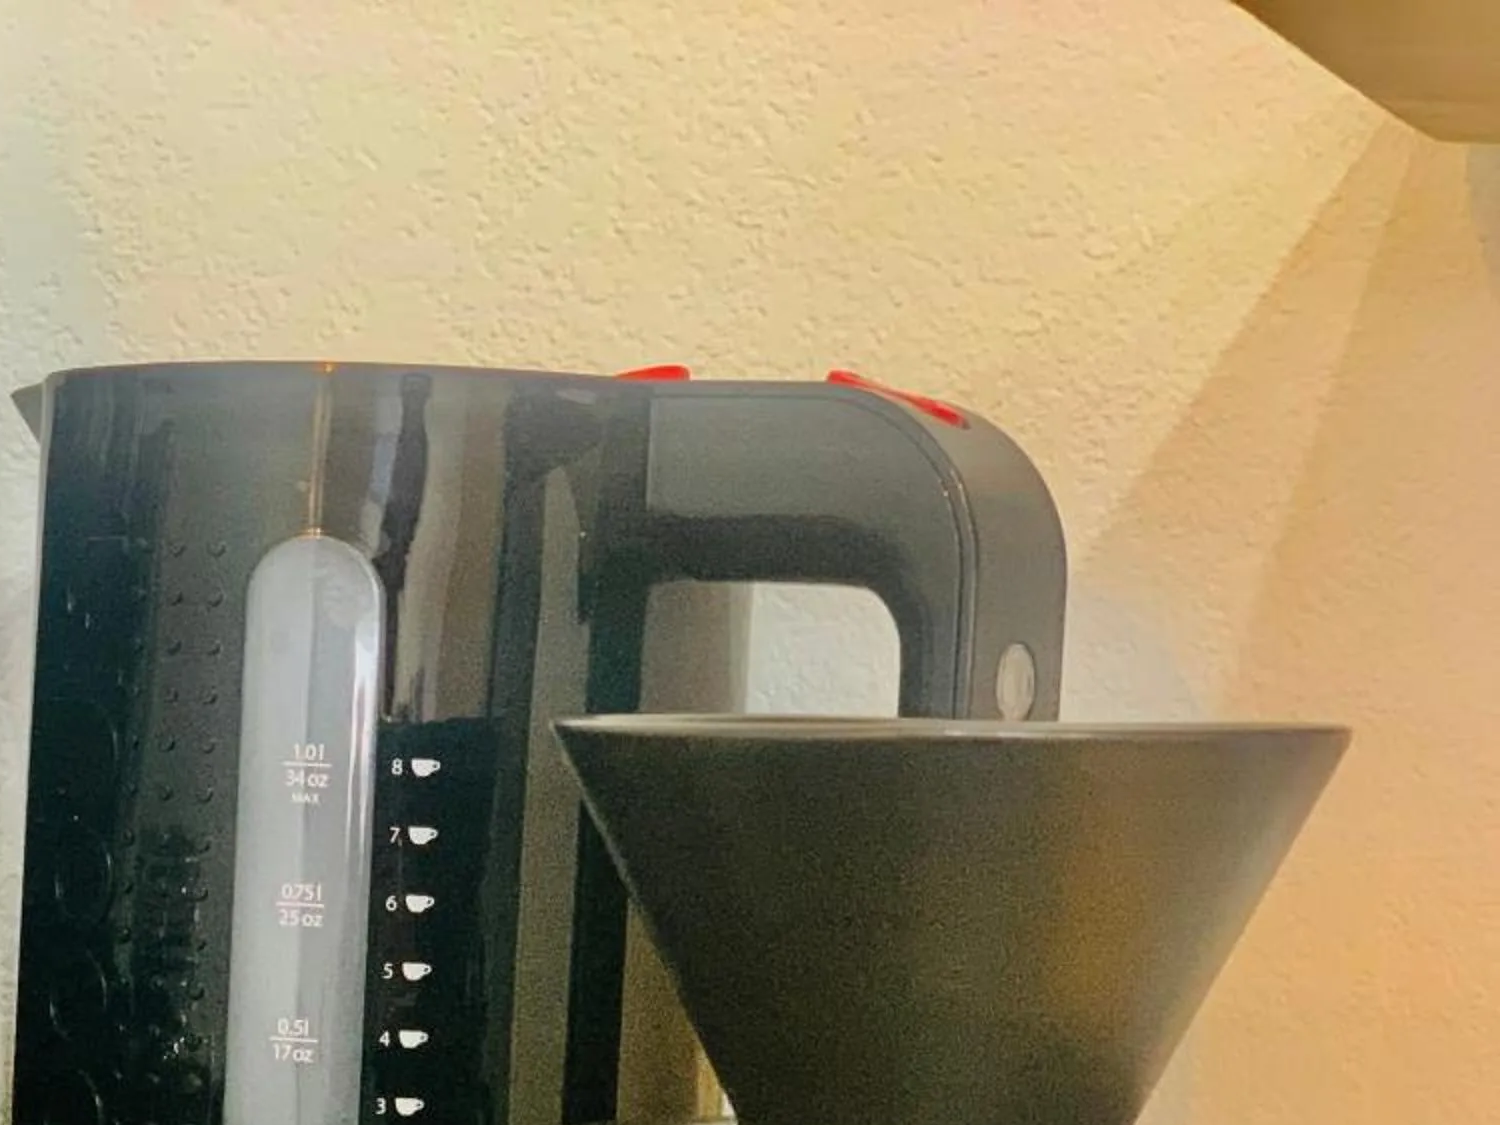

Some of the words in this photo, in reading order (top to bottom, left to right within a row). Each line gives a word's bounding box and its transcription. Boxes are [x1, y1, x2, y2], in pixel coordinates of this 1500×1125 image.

[391, 757, 403, 776] 8
[285, 768, 305, 788] 34
[306, 773, 329, 788] oz
[389, 826, 401, 844] 7
[385, 895, 397, 912] 6
[278, 908, 300, 926] 25
[301, 913, 324, 928] oz
[382, 962, 393, 979] 5
[379, 1030, 390, 1047] 4
[274, 1044, 290, 1062] 17
[292, 1050, 314, 1063] oz
[375, 1097, 387, 1114] 3
